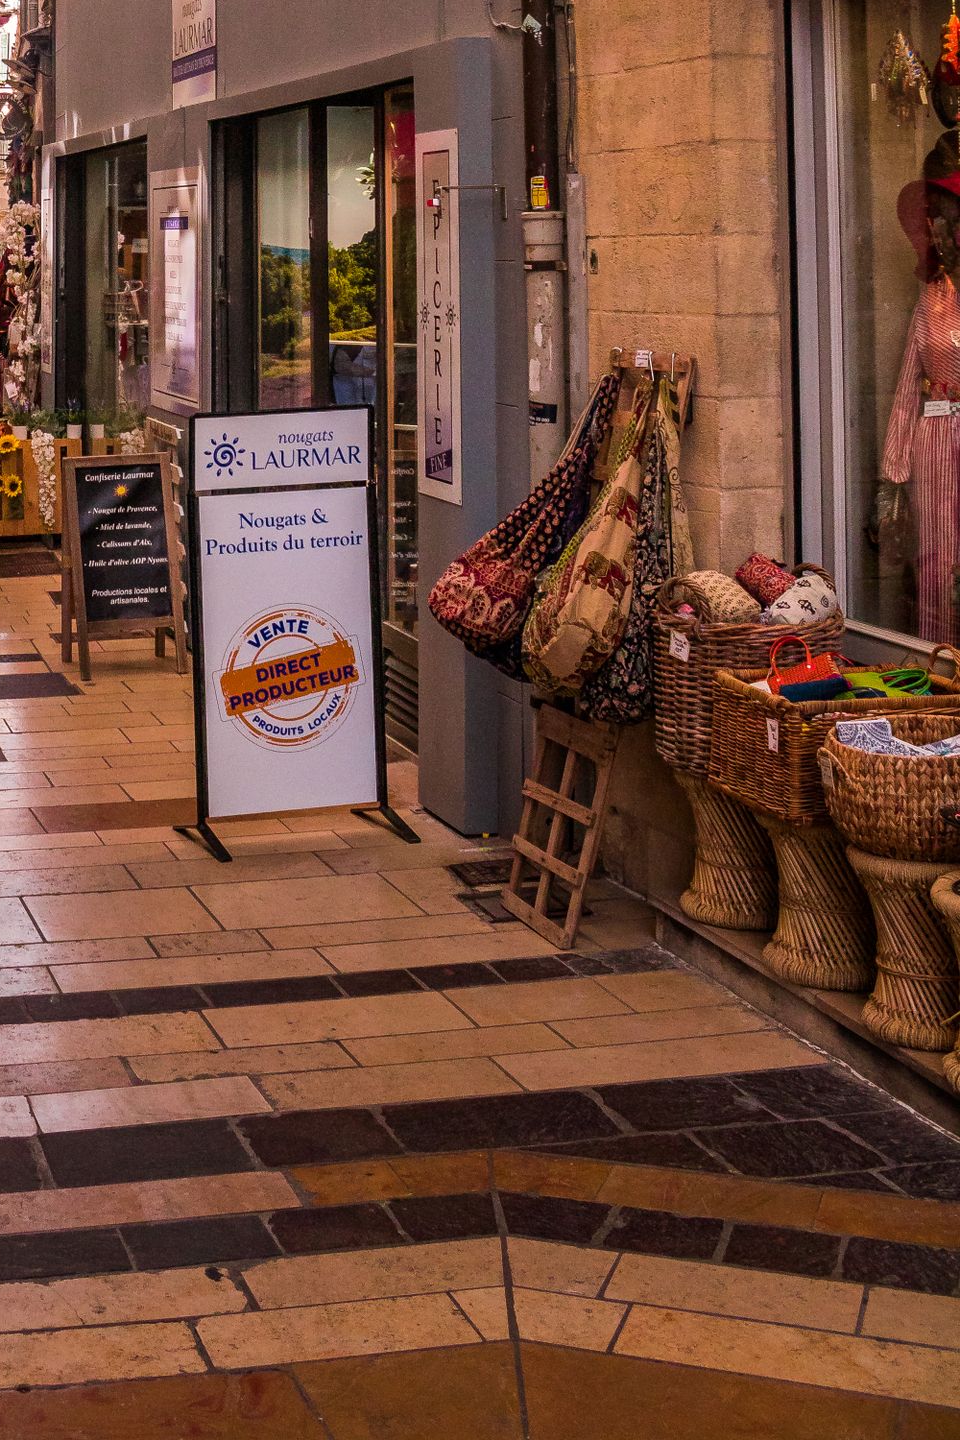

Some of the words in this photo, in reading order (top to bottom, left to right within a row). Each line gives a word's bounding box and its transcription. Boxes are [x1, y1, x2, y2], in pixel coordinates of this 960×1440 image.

[173, 17, 214, 57] LAURMAR
[278, 430, 334, 446] nougats
[250, 445, 362, 471] LAURMAR
[430, 452, 448, 474] FINE
[84, 472, 121, 483] Confiserie
[122, 471, 154, 480] Laurmar
[92, 507, 117, 515] Nougat
[238, 512, 307, 530] Nougats
[311, 508, 329, 524] &
[205, 537, 278, 556] Produits
[282, 534, 305, 551] du
[310, 530, 364, 548] terroir
[88, 560, 107, 568] Huile
[107, 559, 130, 567] d'olive
[130, 557, 146, 565] AOP
[91, 588, 133, 597] Productions
[247, 619, 310, 649] VENTE
[255, 652, 321, 683] DIRECT
[229, 664, 355, 710] PRODUCTEUR
[252, 715, 304, 736] PRODUITS
[308, 694, 341, 730] LOCAUX
